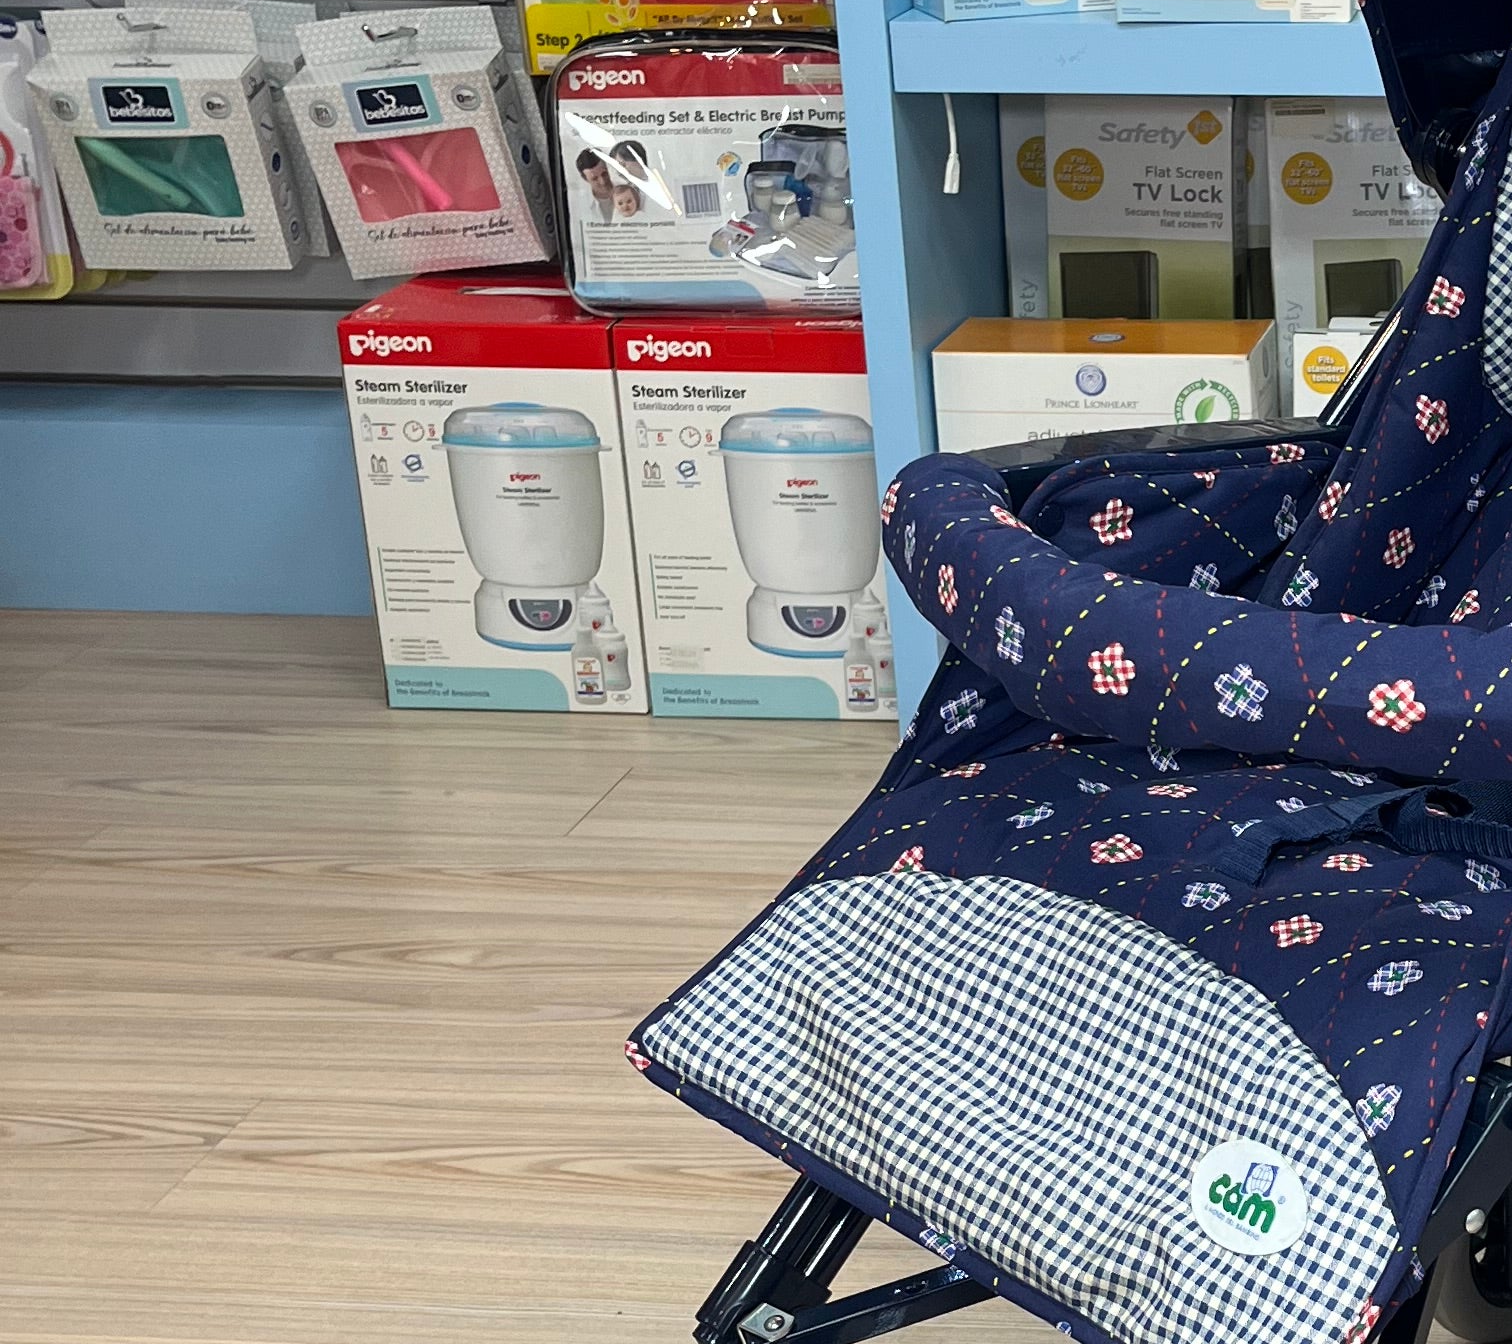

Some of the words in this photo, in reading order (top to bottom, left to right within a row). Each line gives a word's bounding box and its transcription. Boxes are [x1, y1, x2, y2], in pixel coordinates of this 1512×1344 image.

[536, 33, 571, 50] Step
[568, 66, 646, 92] pigeon
[669, 110, 692, 123] Set
[694, 110, 706, 123] &
[709, 109, 757, 123] Electric
[1098, 122, 1187, 150] Safety
[1145, 165, 1172, 179] Flat
[1175, 166, 1223, 181] Screen
[1372, 164, 1399, 177] Flat
[1132, 182, 1163, 202] TV
[1171, 184, 1223, 204] Lock
[1360, 182, 1390, 201] TV
[1125, 207, 1161, 218] Secures
[1163, 208, 1181, 218] free
[1184, 209, 1224, 221] standing
[1352, 208, 1389, 218] Secures
[1390, 208, 1410, 217] free
[1160, 218, 1176, 229] flat
[1178, 220, 1209, 229] screen
[1211, 220, 1223, 230] TV
[348, 329, 433, 357] pigeon
[626, 334, 712, 363] pigeon
[1317, 356, 1336, 366] Fits
[1306, 364, 1347, 374] standard
[1311, 373, 1341, 383] toilets
[355, 379, 401, 393] Steam
[405, 380, 468, 395] Sterilizer
[631, 384, 679, 399] Steam
[683, 385, 747, 400] Sterilizer
[356, 396, 417, 407] Esterilizadora
[419, 398, 426, 406] a
[428, 397, 454, 409] vapor
[633, 402, 694, 412] Esterilizadora
[696, 404, 704, 412] a
[705, 403, 732, 414] vapor
[1045, 398, 1081, 409] PRINCE
[509, 471, 541, 483] pigeon
[785, 477, 818, 489] pigeon
[1208, 1173, 1277, 1234] cam
